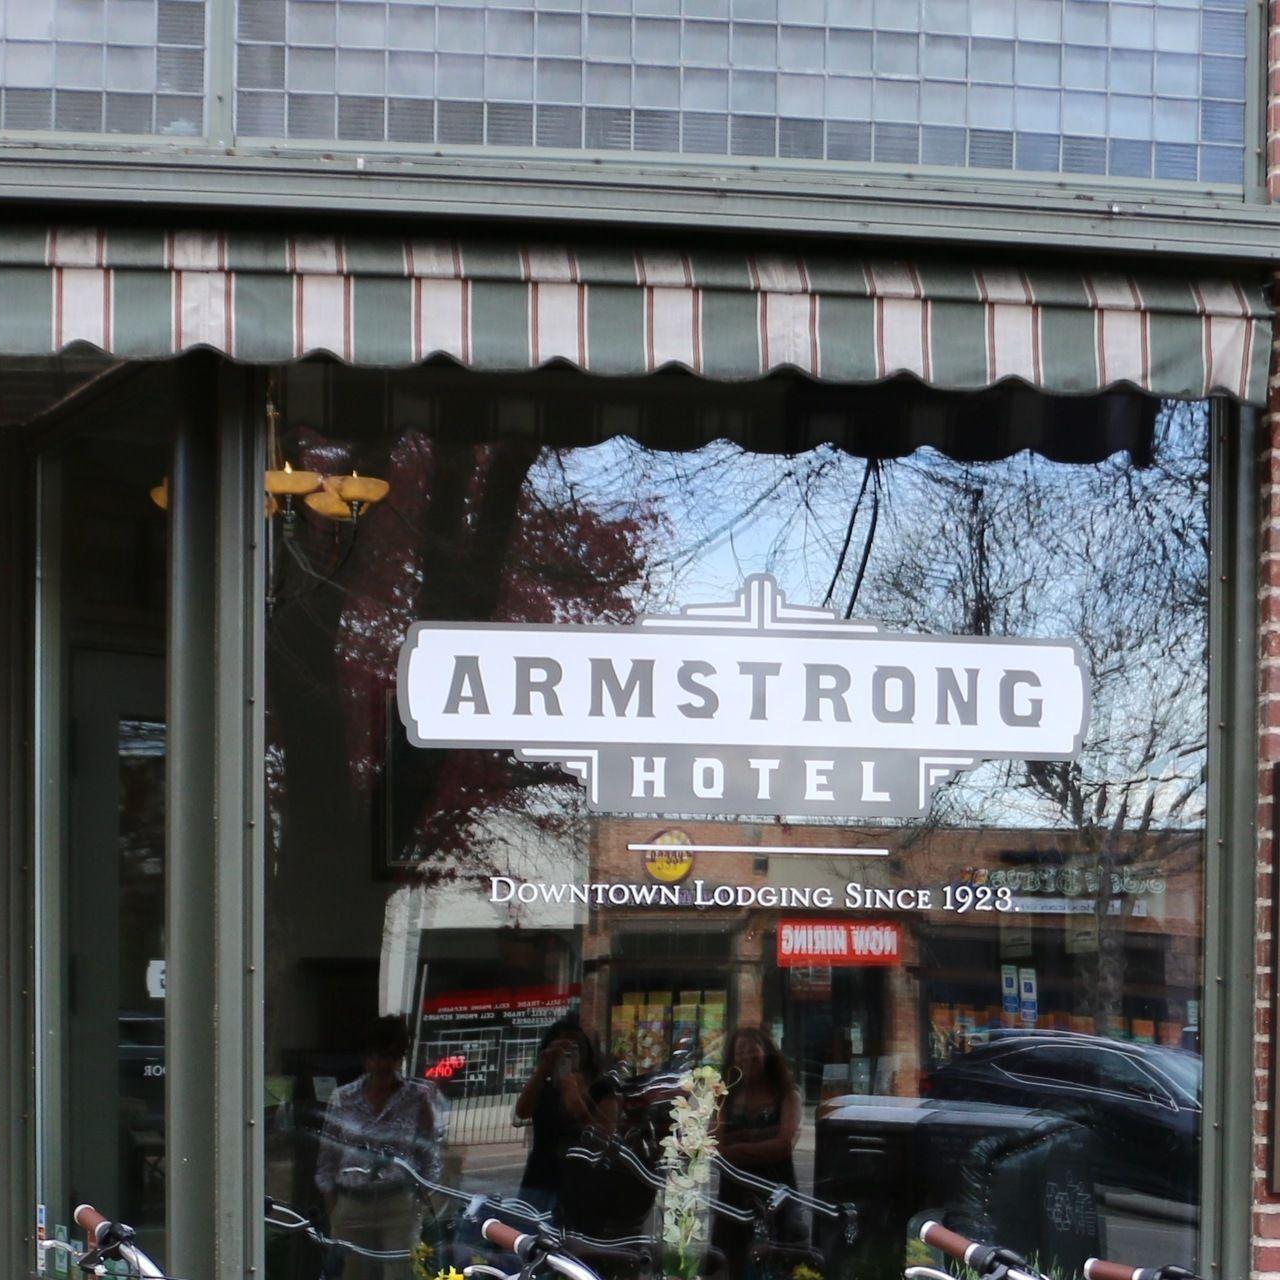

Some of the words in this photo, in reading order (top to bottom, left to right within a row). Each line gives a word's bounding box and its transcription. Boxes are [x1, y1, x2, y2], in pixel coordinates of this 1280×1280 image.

[442, 653, 1046, 728] ARMSTRONG
[631, 755, 891, 802] HOTEL
[942, 882, 1021, 913] 1923.
